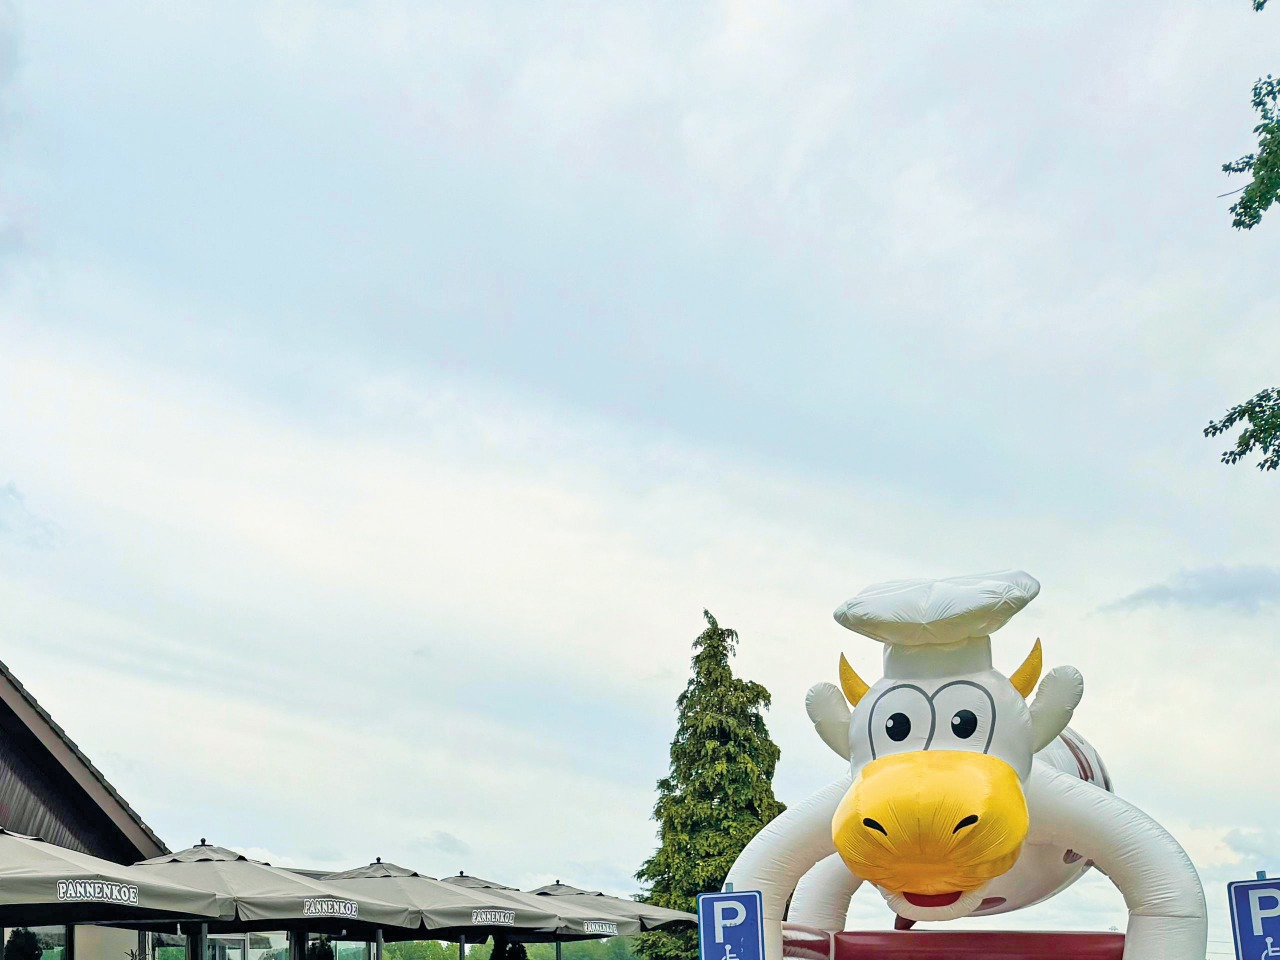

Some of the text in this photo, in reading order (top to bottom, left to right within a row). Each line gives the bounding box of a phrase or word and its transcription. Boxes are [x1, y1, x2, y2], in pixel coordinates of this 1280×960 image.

[59, 882, 137, 903] PANNENKOE
[304, 900, 357, 917] PANNENKOE
[472, 910, 515, 924] PANNENKOE
[713, 900, 747, 943] P
